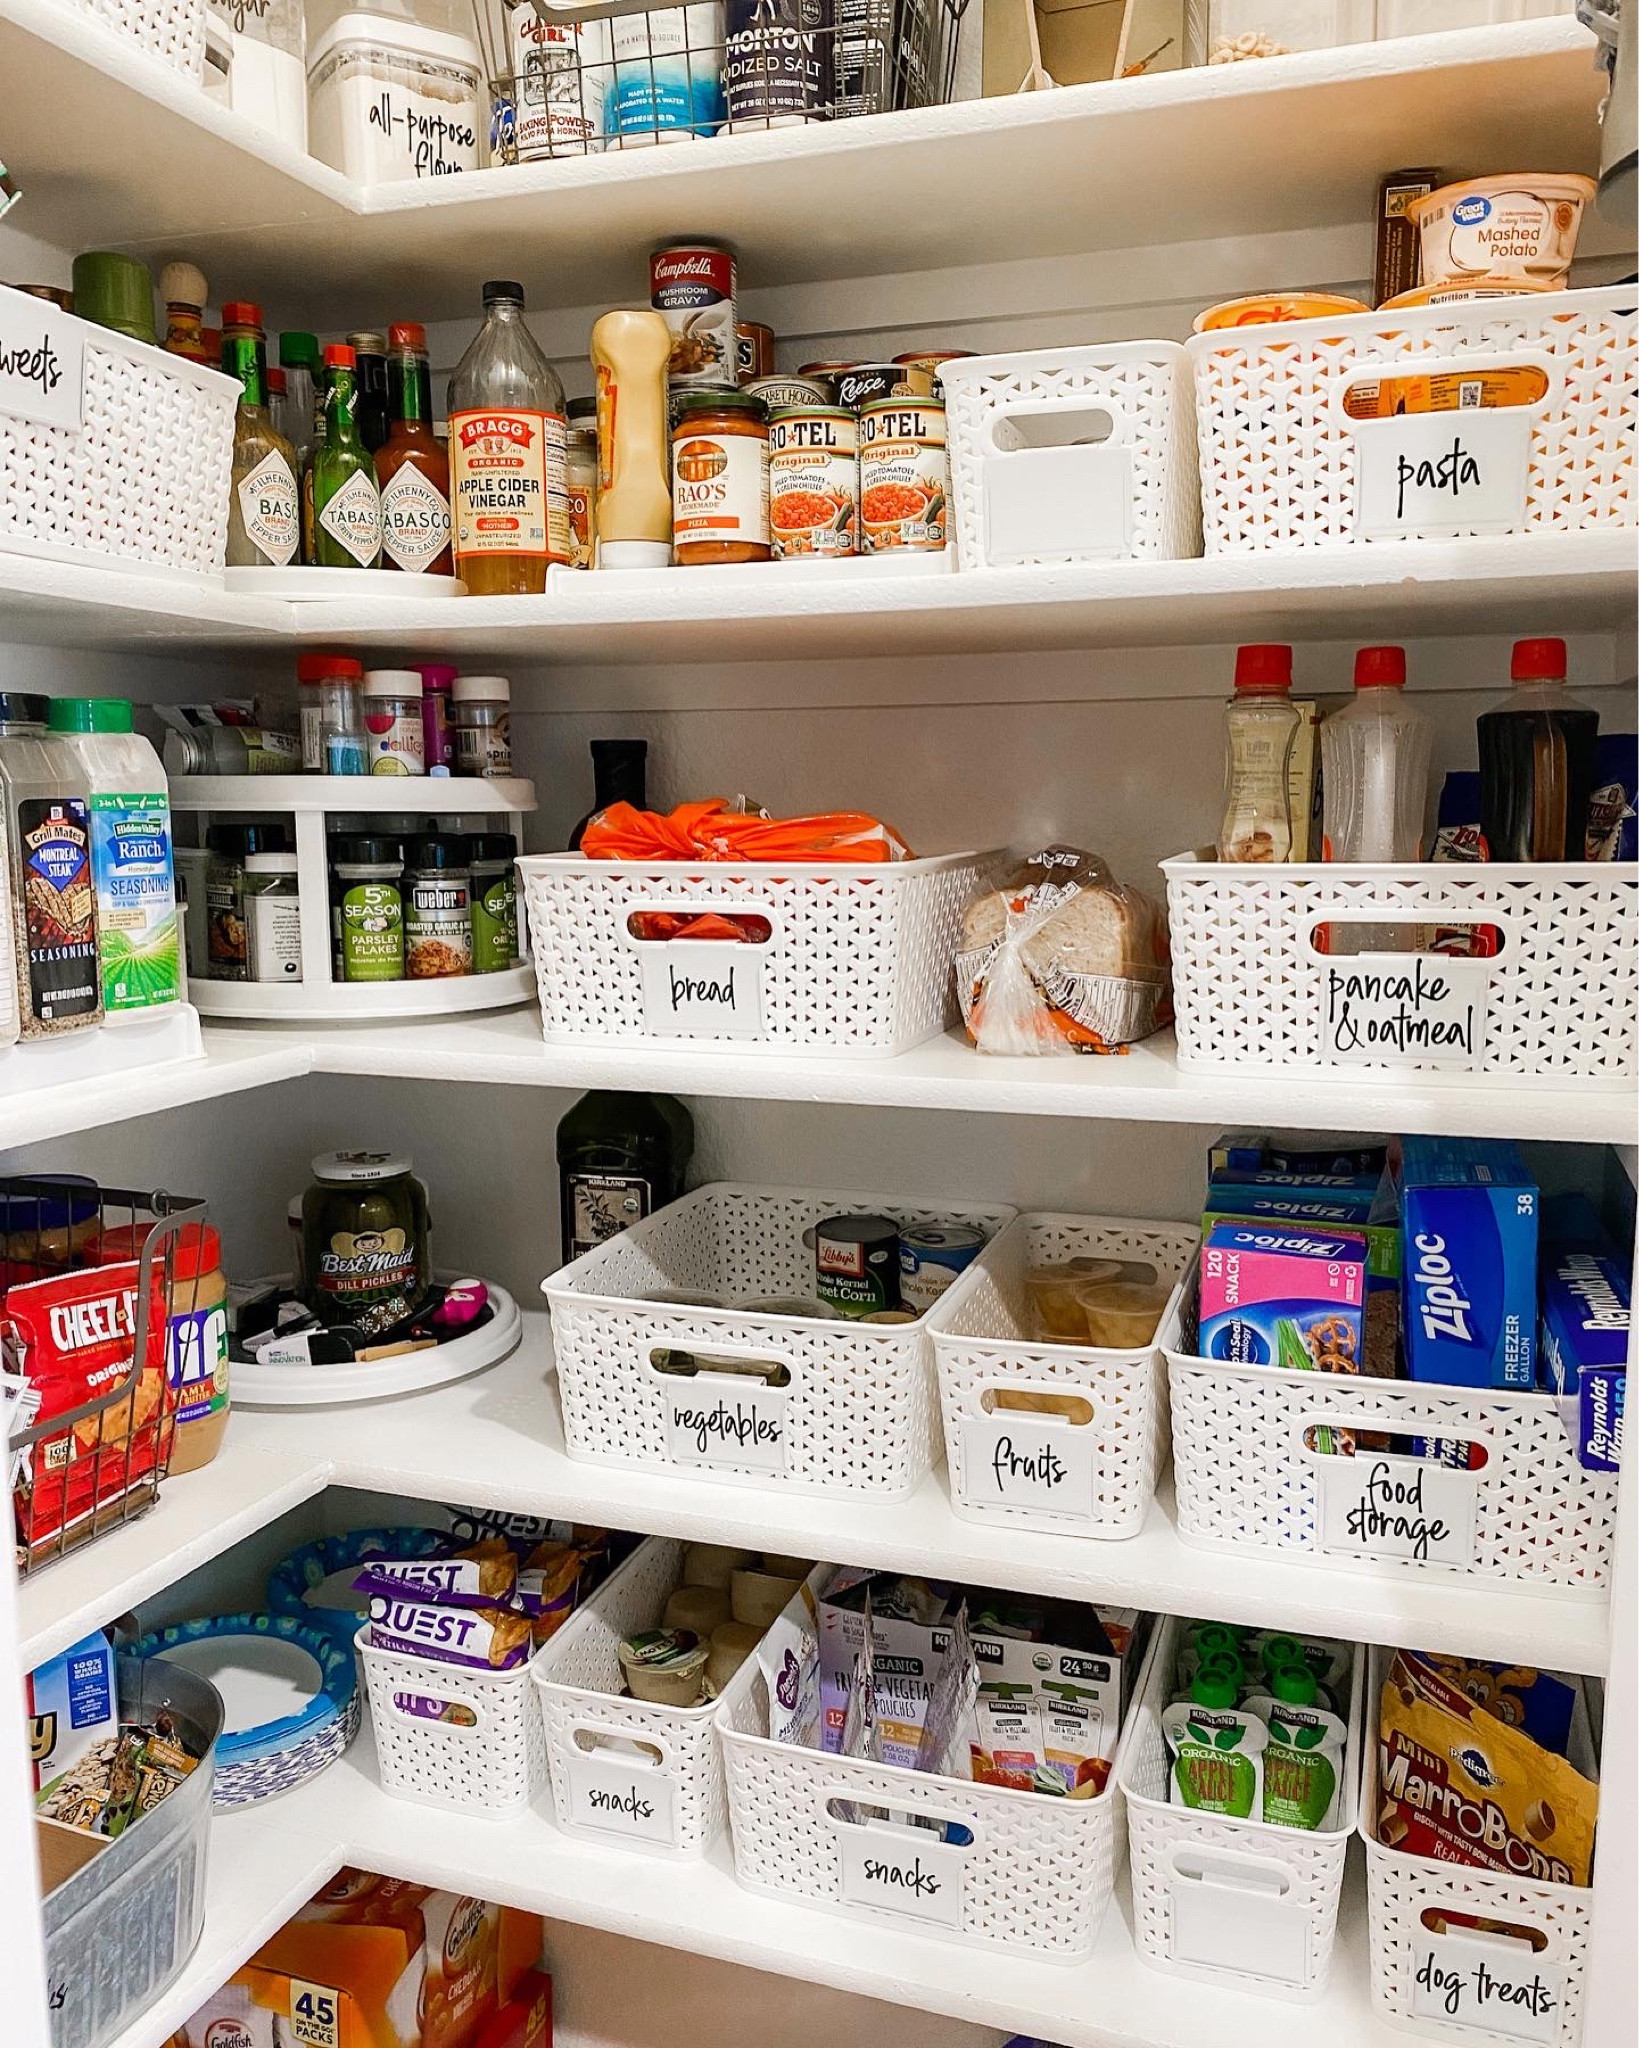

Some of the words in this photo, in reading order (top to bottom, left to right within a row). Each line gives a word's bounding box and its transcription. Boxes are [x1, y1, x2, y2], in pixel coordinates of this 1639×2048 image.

[532, 28, 566, 43] GIRL
[726, 27, 815, 58] MORTON
[720, 56, 780, 84] IODIZED
[784, 56, 822, 77] SALT
[369, 93, 476, 152] all-purpose
[550, 114, 595, 131] POWDER
[1455, 200, 1485, 215] Great
[1478, 227, 1541, 243] Mashed
[1490, 242, 1538, 257] Potato
[655, 256, 712, 280] Campbell's
[658, 287, 709, 298] MUSHROOM
[663, 296, 701, 307] GRAVY
[0, 334, 63, 394] weets
[839, 377, 883, 406] Reese
[466, 420, 523, 439] BRAGG
[472, 459, 518, 467] ORGANIC
[774, 455, 826, 468] Original
[864, 447, 915, 461] Original
[460, 478, 494, 495] APPLE
[497, 478, 540, 494] CIDER
[1397, 437, 1480, 519] pasta
[469, 494, 526, 509] VINEGAR
[678, 483, 727, 504] RAO'S
[381, 512, 451, 529] ABASCO
[385, 529, 416, 554] PEPPER
[416, 529, 442, 553] SAUCE
[398, 528, 428, 536] BRAND
[32, 830, 52, 845] Grill
[54, 826, 82, 842] Mates
[116, 824, 142, 835] Hidden
[38, 847, 79, 863] MONTREAL
[118, 840, 162, 859] Ranch
[48, 862, 73, 877] STEAK
[111, 876, 169, 896] SEASONING
[417, 888, 457, 909] weber
[345, 903, 401, 918] SEASON
[434, 921, 458, 931] GARLIC
[352, 934, 399, 945] PARSLEY
[355, 944, 398, 955] FLAKES
[30, 943, 95, 964] SEASONING
[668, 964, 734, 1011] bread
[1329, 958, 1450, 1024] pancake
[1255, 1173, 1355, 1186] Ziploc
[1253, 1199, 1348, 1218] Ziploc
[1517, 1193, 1534, 1216] 38
[1234, 1231, 1336, 1256] Ziploc
[322, 1253, 366, 1274] Best
[365, 1243, 414, 1273] Maid
[1206, 1250, 1224, 1279] 120
[337, 1280, 359, 1290] DILL
[361, 1271, 403, 1289] PICKLES
[835, 1277, 869, 1290] Kernel
[1225, 1252, 1241, 1305] SNACK
[1413, 1233, 1473, 1342] Ziploc
[840, 1289, 877, 1303] Corn
[1504, 1314, 1520, 1382] FREEZER
[1519, 1336, 1531, 1383] GALLON
[673, 1399, 784, 1454] vegetables
[1586, 1376, 1609, 1460] Reynolds
[991, 1435, 1068, 1493] fruits
[1366, 1461, 1424, 1520] food
[1346, 1496, 1450, 1561] storage
[369, 1593, 477, 1646] QUEST
[73, 1657, 102, 1670] 100%
[74, 1664, 102, 1675] WHOLE
[1062, 1658, 1082, 1675] 24
[74, 1669, 103, 1680] GRAINS
[1419, 1674, 1450, 1702] RESEALABLE
[828, 1711, 844, 1726] 12
[874, 1698, 917, 1719] POUCHES
[1049, 1702, 1088, 1716] KIRKLAND
[1191, 1709, 1236, 1726] KIRKLAND
[1273, 1706, 1318, 1725] KIRKLAND
[878, 1723, 895, 1737] 12
[1180, 1747, 1241, 1767] ORGANIC
[1397, 1733, 1442, 1774] Mini
[588, 1786, 655, 1821] snacks
[1413, 1811, 1438, 1830] BISCUIT
[1437, 1824, 1454, 1842] WITH
[1453, 1834, 1474, 1852] TASTY
[1473, 1846, 1489, 1862] BONE
[1433, 1840, 1460, 1864] REAL
[863, 1857, 942, 1897] snacks
[1415, 1952, 1467, 2015] dog
[1471, 1963, 1557, 2017] treats
[295, 1991, 334, 2025] 45
[295, 2025, 334, 2045] PACKS
